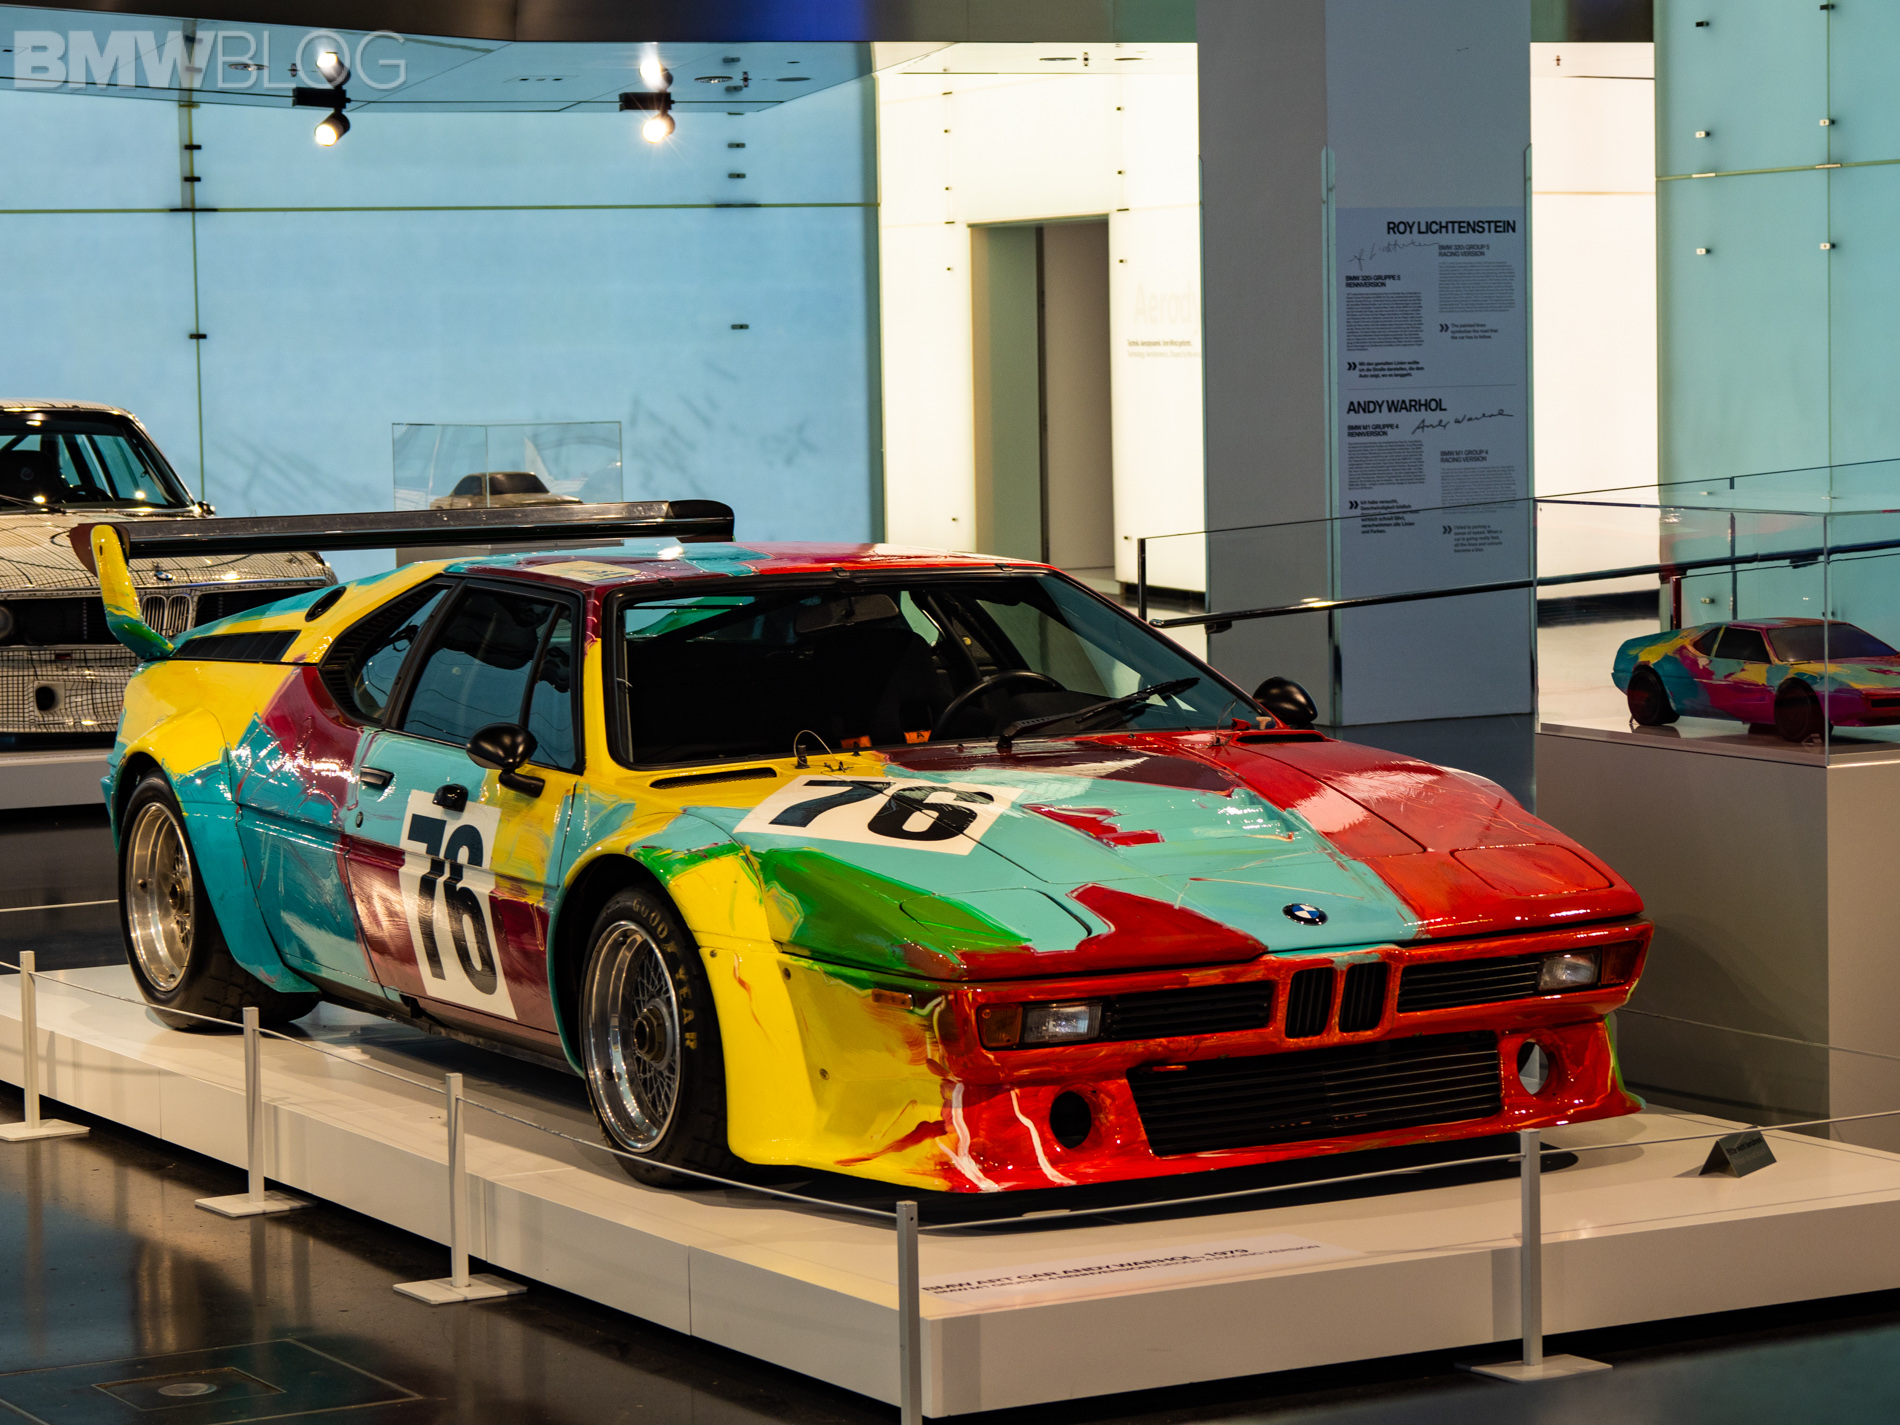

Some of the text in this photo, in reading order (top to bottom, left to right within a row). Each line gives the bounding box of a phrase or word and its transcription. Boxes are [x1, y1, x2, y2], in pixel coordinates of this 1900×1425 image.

[1387, 220, 1516, 234] ROY LICHTENSTEIN
[1465, 243, 1485, 251] GROUP
[1347, 398, 1447, 414] ANDY WARHOL
[768, 779, 994, 841] 76
[407, 813, 498, 996] 76
[976, 1276, 1013, 1285] ART
[1016, 1271, 1060, 1280] CAR
[1062, 1264, 1111, 1275] ANDY
[1204, 1249, 1248, 1257] 1979
